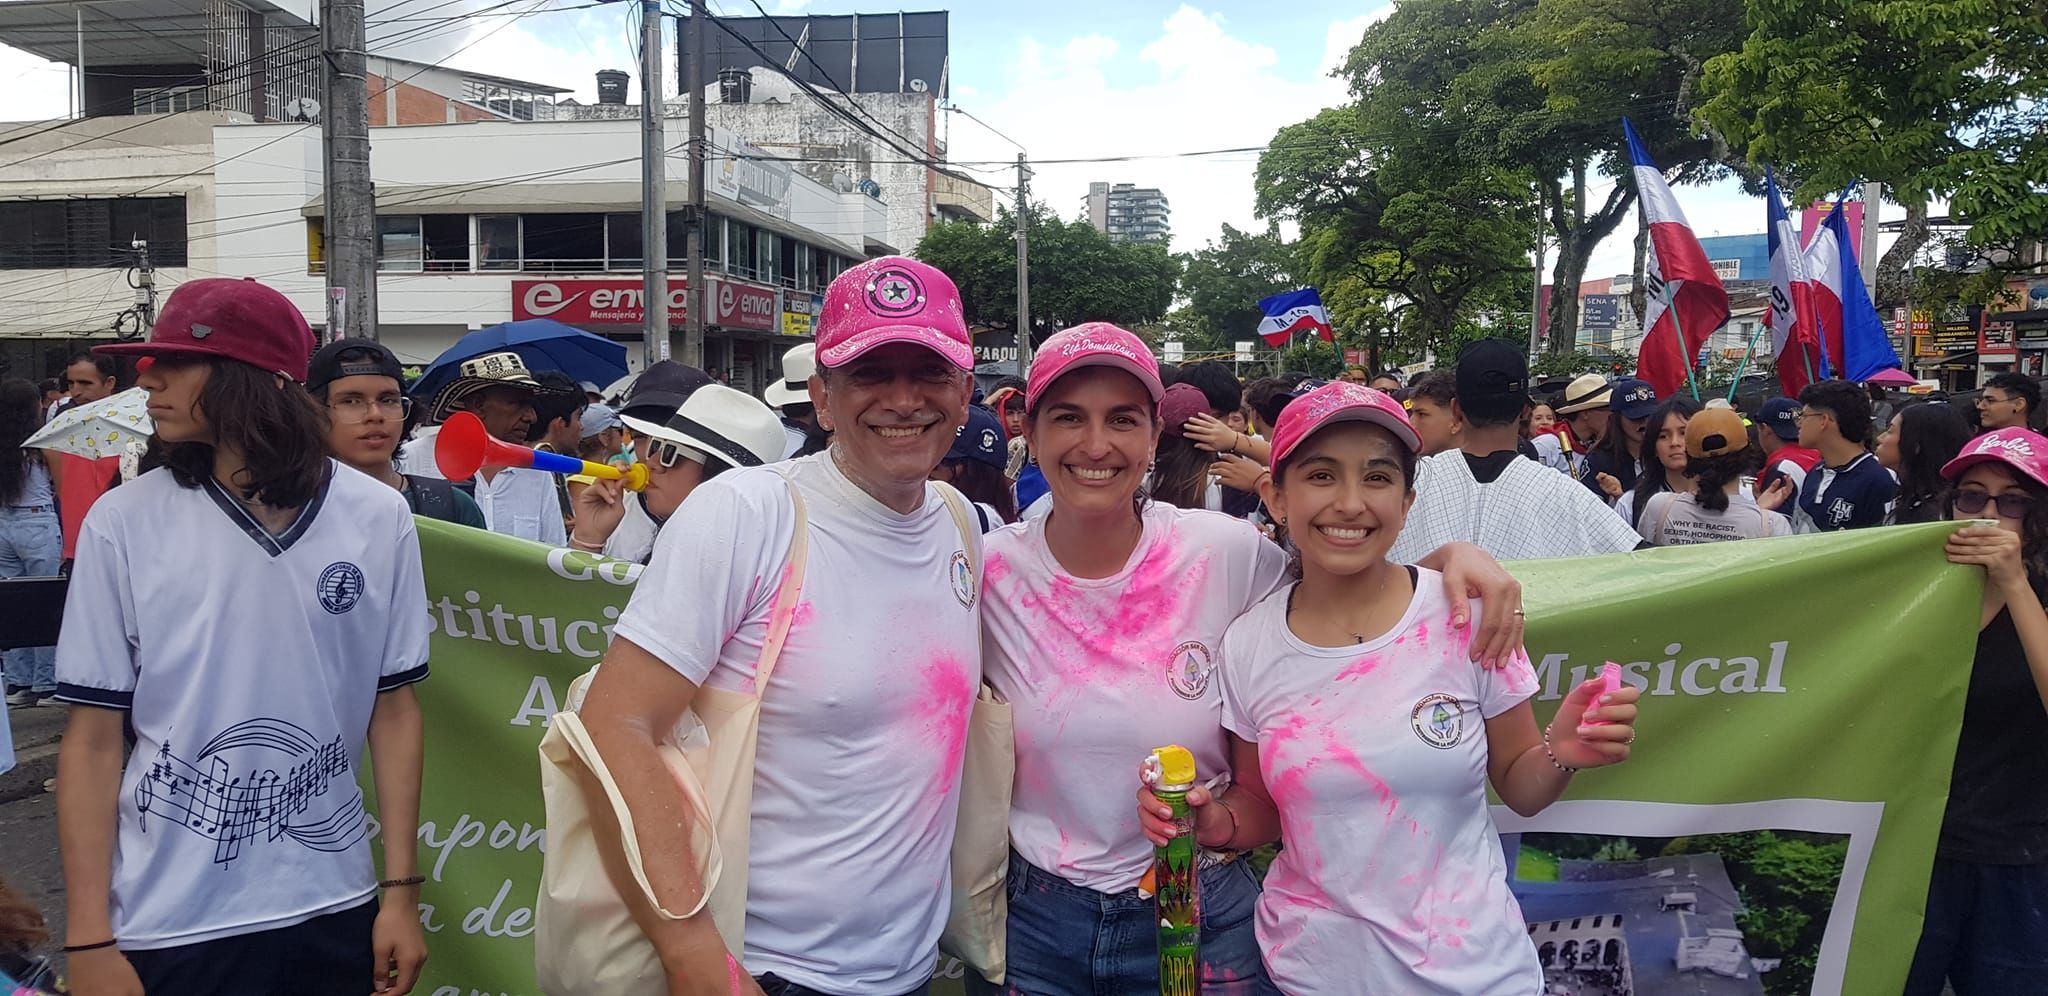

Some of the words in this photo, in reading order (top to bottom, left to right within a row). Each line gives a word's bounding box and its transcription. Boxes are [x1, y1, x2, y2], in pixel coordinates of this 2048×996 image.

[589, 288, 688, 309] ena
[973, 346, 1036, 361] PARQU
[1692, 521, 1704, 529] BE
[1705, 523, 1737, 532] RACIST,
